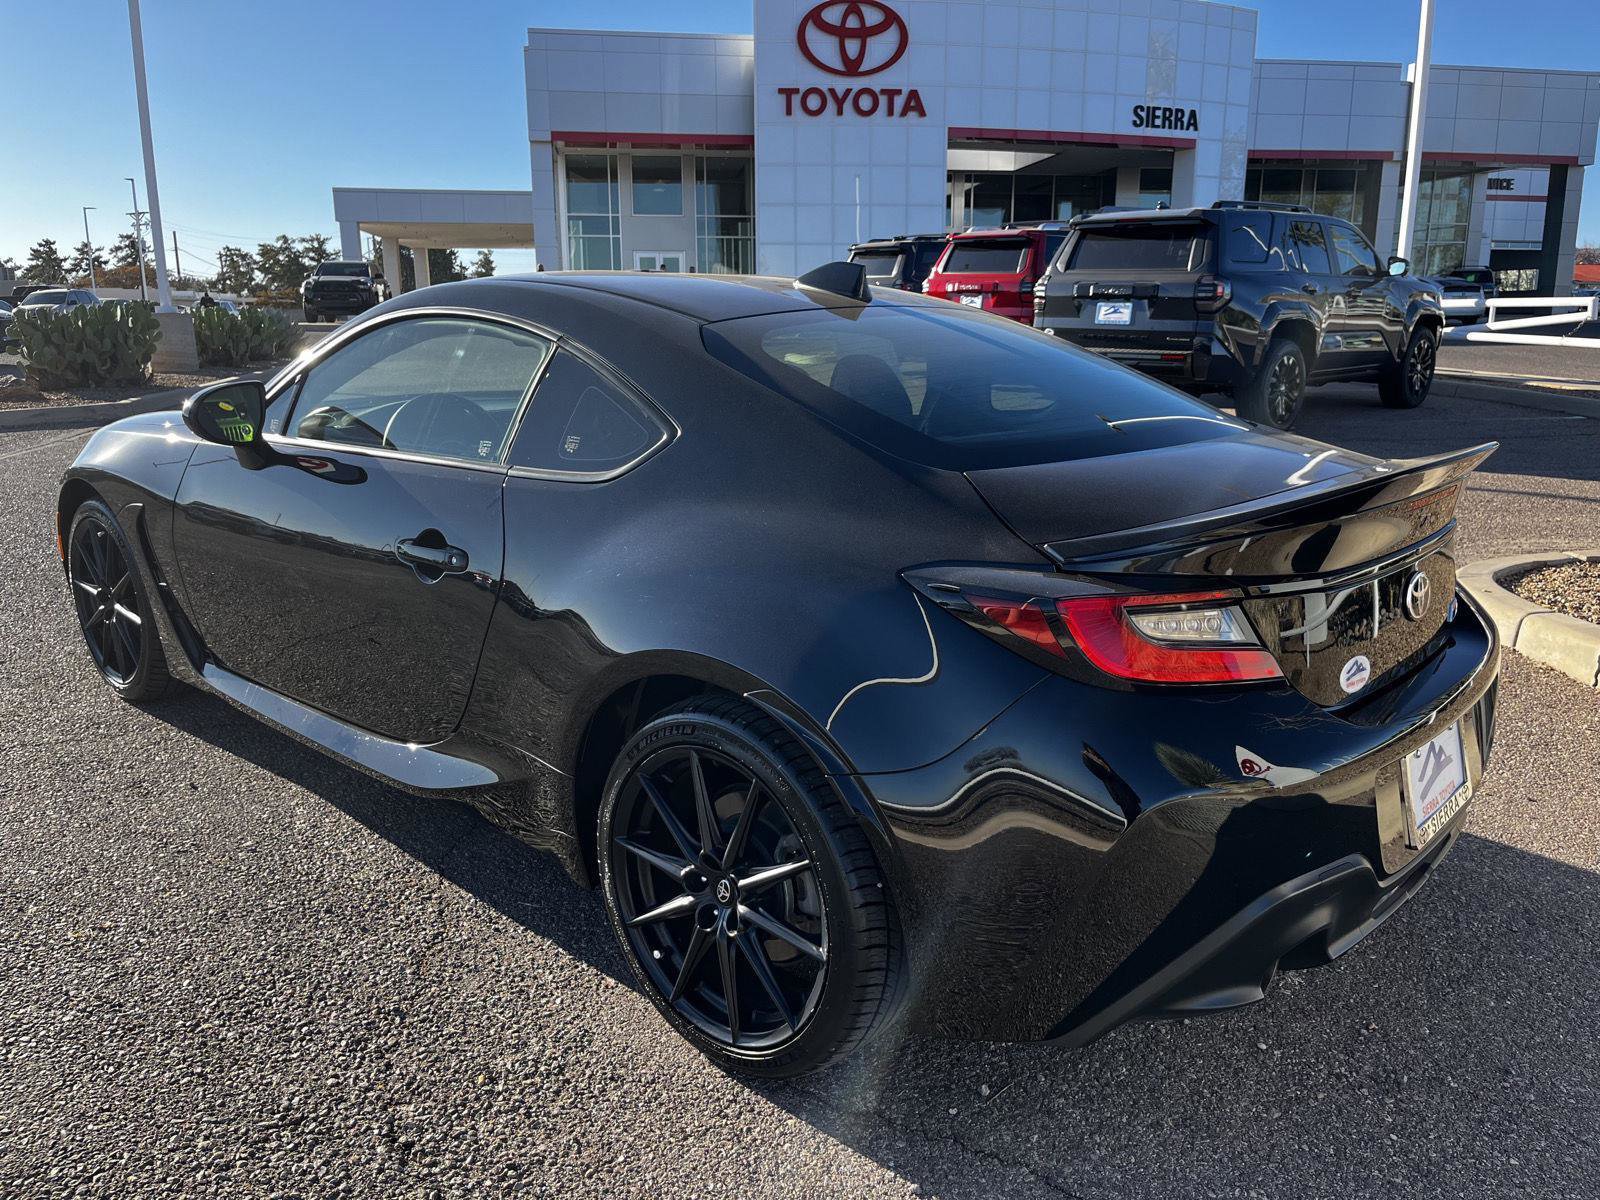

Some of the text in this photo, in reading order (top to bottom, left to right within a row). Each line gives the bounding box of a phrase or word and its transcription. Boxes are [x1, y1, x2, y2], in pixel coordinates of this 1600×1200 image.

[778, 87, 927, 117] TOYOTA
[1132, 105, 1198, 131] SIERRA
[638, 725, 694, 749] MICHELIN
[1422, 796, 1440, 817] SIERRA
[1430, 797, 1460, 833] SIERRA
